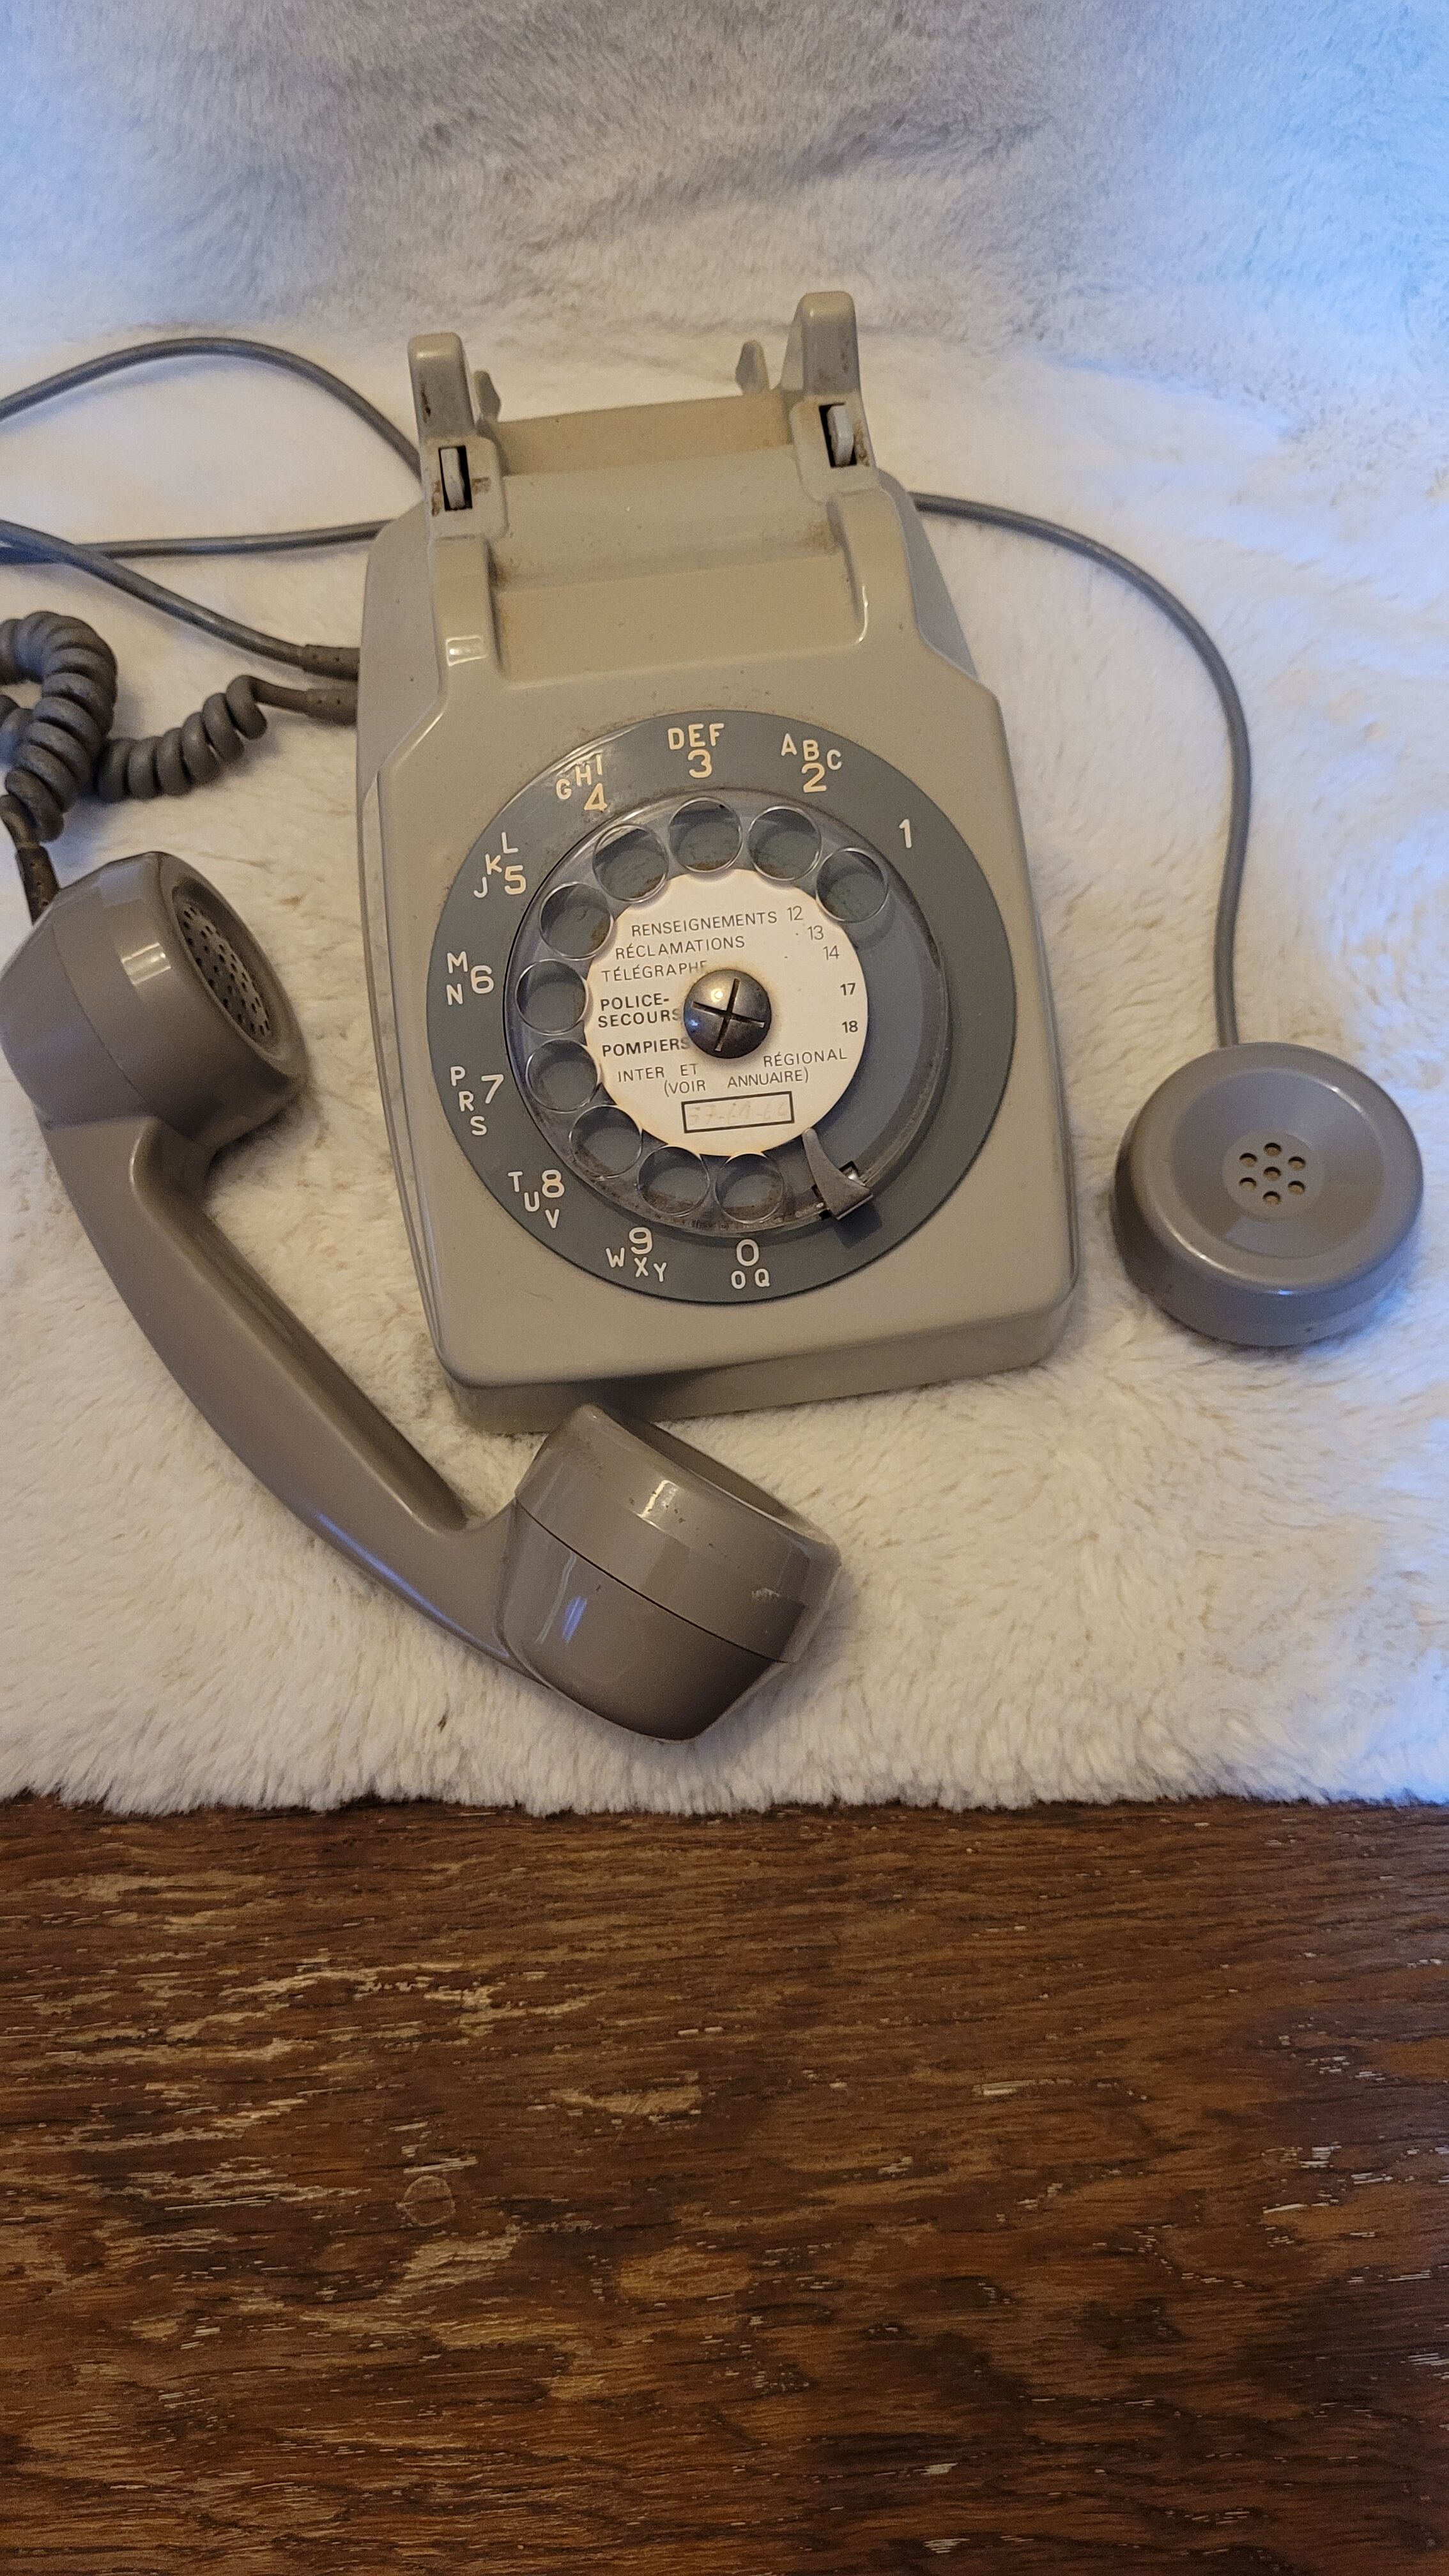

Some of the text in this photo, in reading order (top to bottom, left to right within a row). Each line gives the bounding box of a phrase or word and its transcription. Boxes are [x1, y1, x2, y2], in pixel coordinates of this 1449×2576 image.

[668, 723, 724, 750] DEF
[781, 733, 843, 770] ABC
[687, 749, 712, 778] 3
[801, 762, 827, 793] 2
[584, 783, 608, 813] 4
[898, 818, 912, 848] 1
[504, 865, 526, 894] 5
[631, 906, 804, 937] RENSEIGNEMENTS 12
[615, 925, 824, 960] RÉCLAMATIONS 13
[823, 945, 839, 960] 14
[470, 965, 494, 994] 6
[601, 983, 856, 1011] POLICE- 17
[598, 1008, 681, 1028] SECOURS
[602, 1021, 859, 1057] POMPIERS 18
[618, 1048, 848, 1082] INTER ET RÉGIONAL
[480, 1074, 504, 1104] 7
[664, 1067, 809, 1098] (VOIR ANNUAIRE)
[541, 1169, 565, 1199] 8
[629, 1227, 653, 1255] 9
[606, 1247, 668, 1282] WXY
